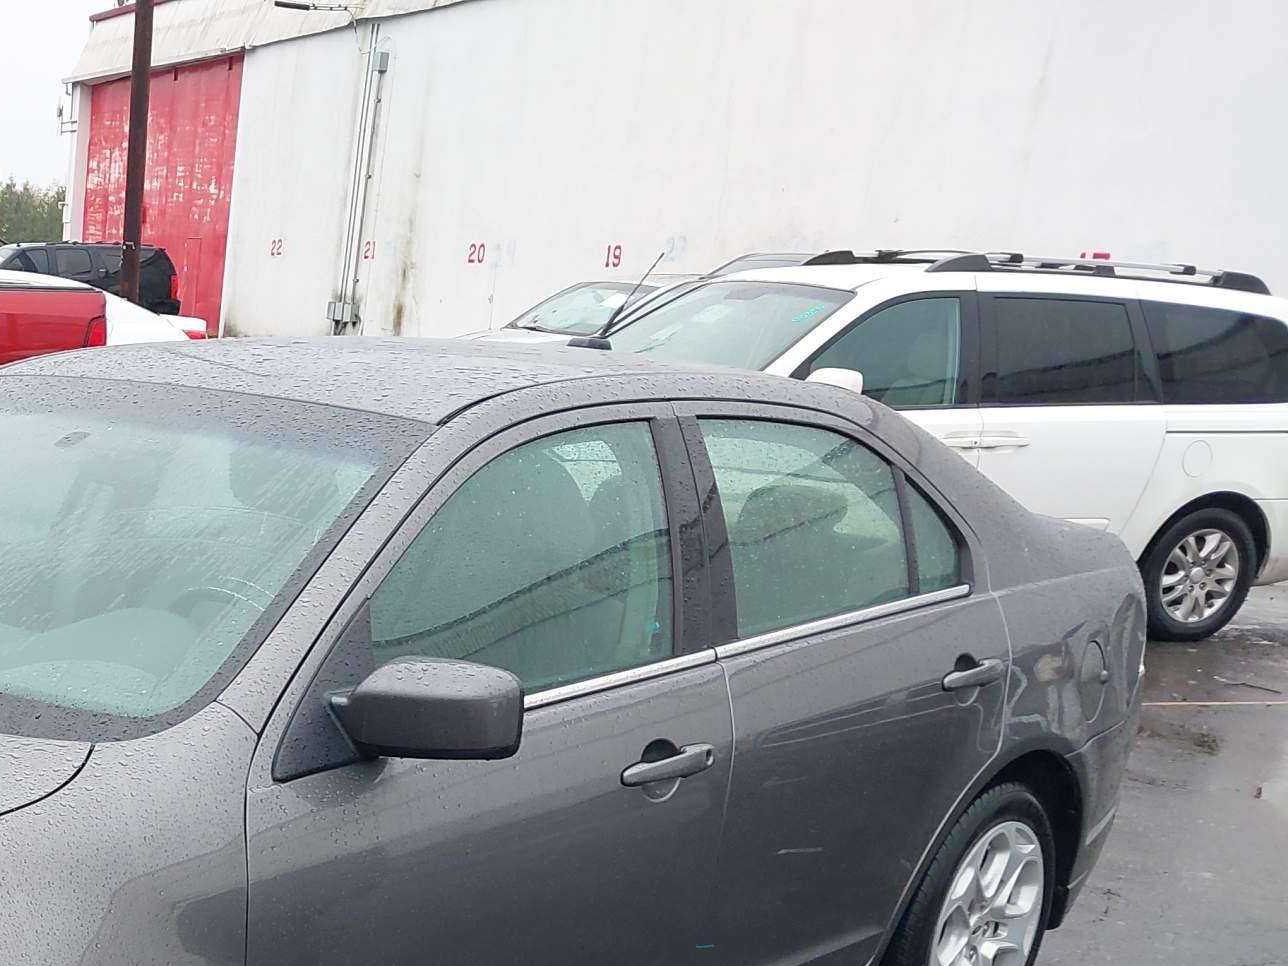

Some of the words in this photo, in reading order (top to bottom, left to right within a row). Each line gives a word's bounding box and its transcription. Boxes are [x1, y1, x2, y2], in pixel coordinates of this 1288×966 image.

[270, 239, 283, 256] 22
[363, 240, 376, 260] 21
[468, 243, 486, 263] 20
[604, 245, 623, 268] 19
